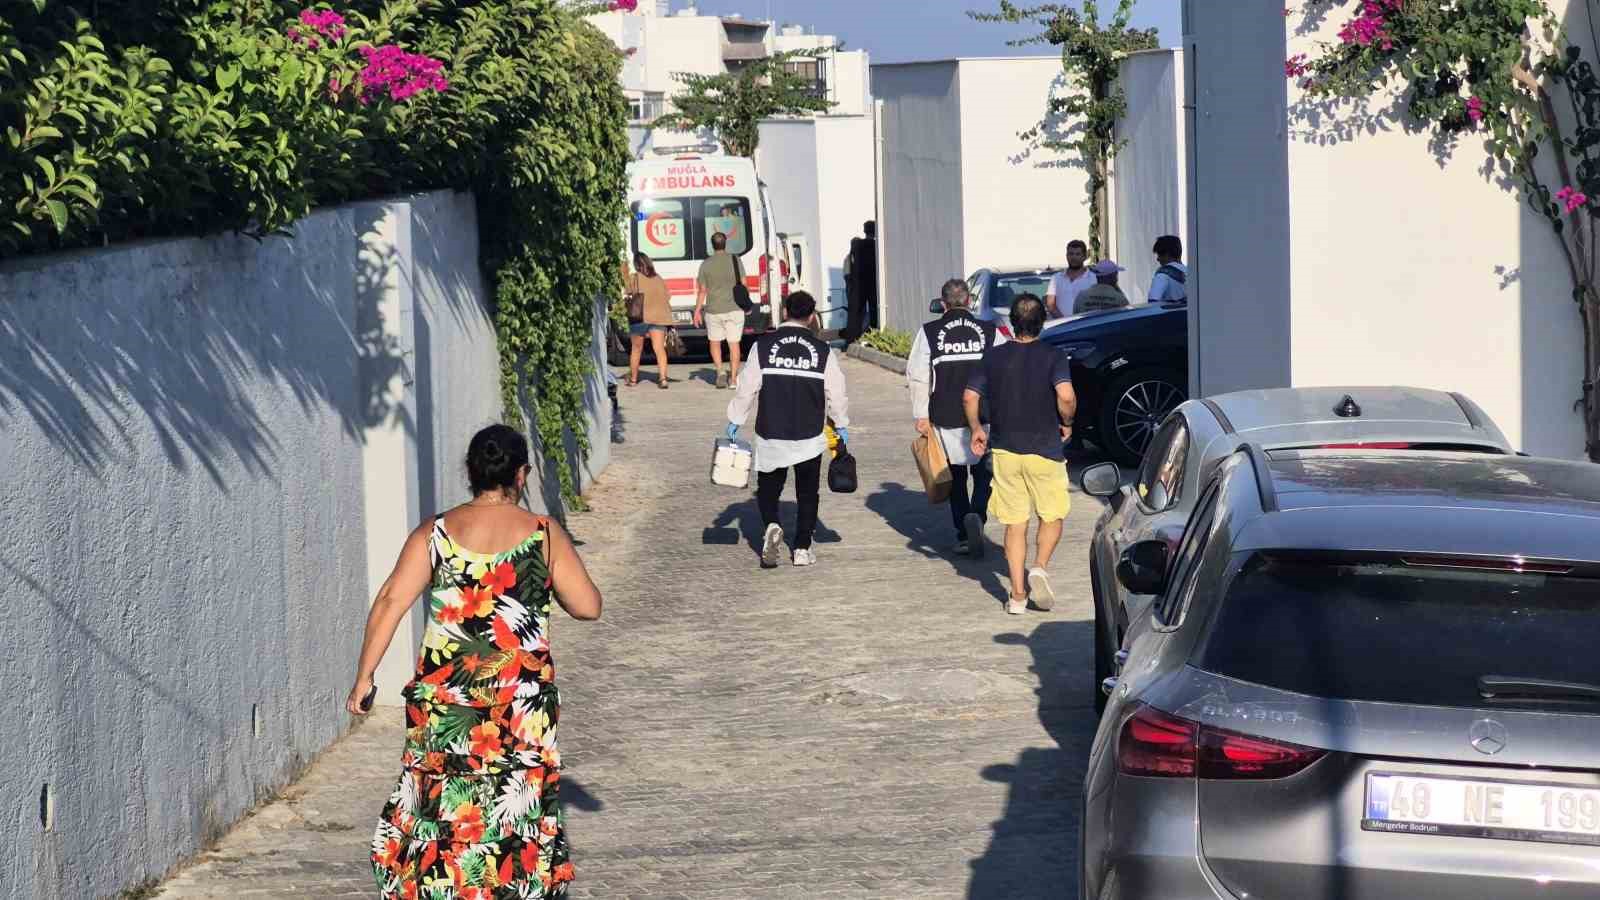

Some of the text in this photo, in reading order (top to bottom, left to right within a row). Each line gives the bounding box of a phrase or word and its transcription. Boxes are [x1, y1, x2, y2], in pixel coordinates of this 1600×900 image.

[667, 164, 707, 174] MUĞLA
[653, 223, 677, 236] 112
[768, 343, 780, 364] OLAY
[944, 339, 981, 354] POLİS
[775, 356, 811, 370] POLİS
[1463, 784, 1505, 824] NE
[1540, 789, 1600, 830] 199
